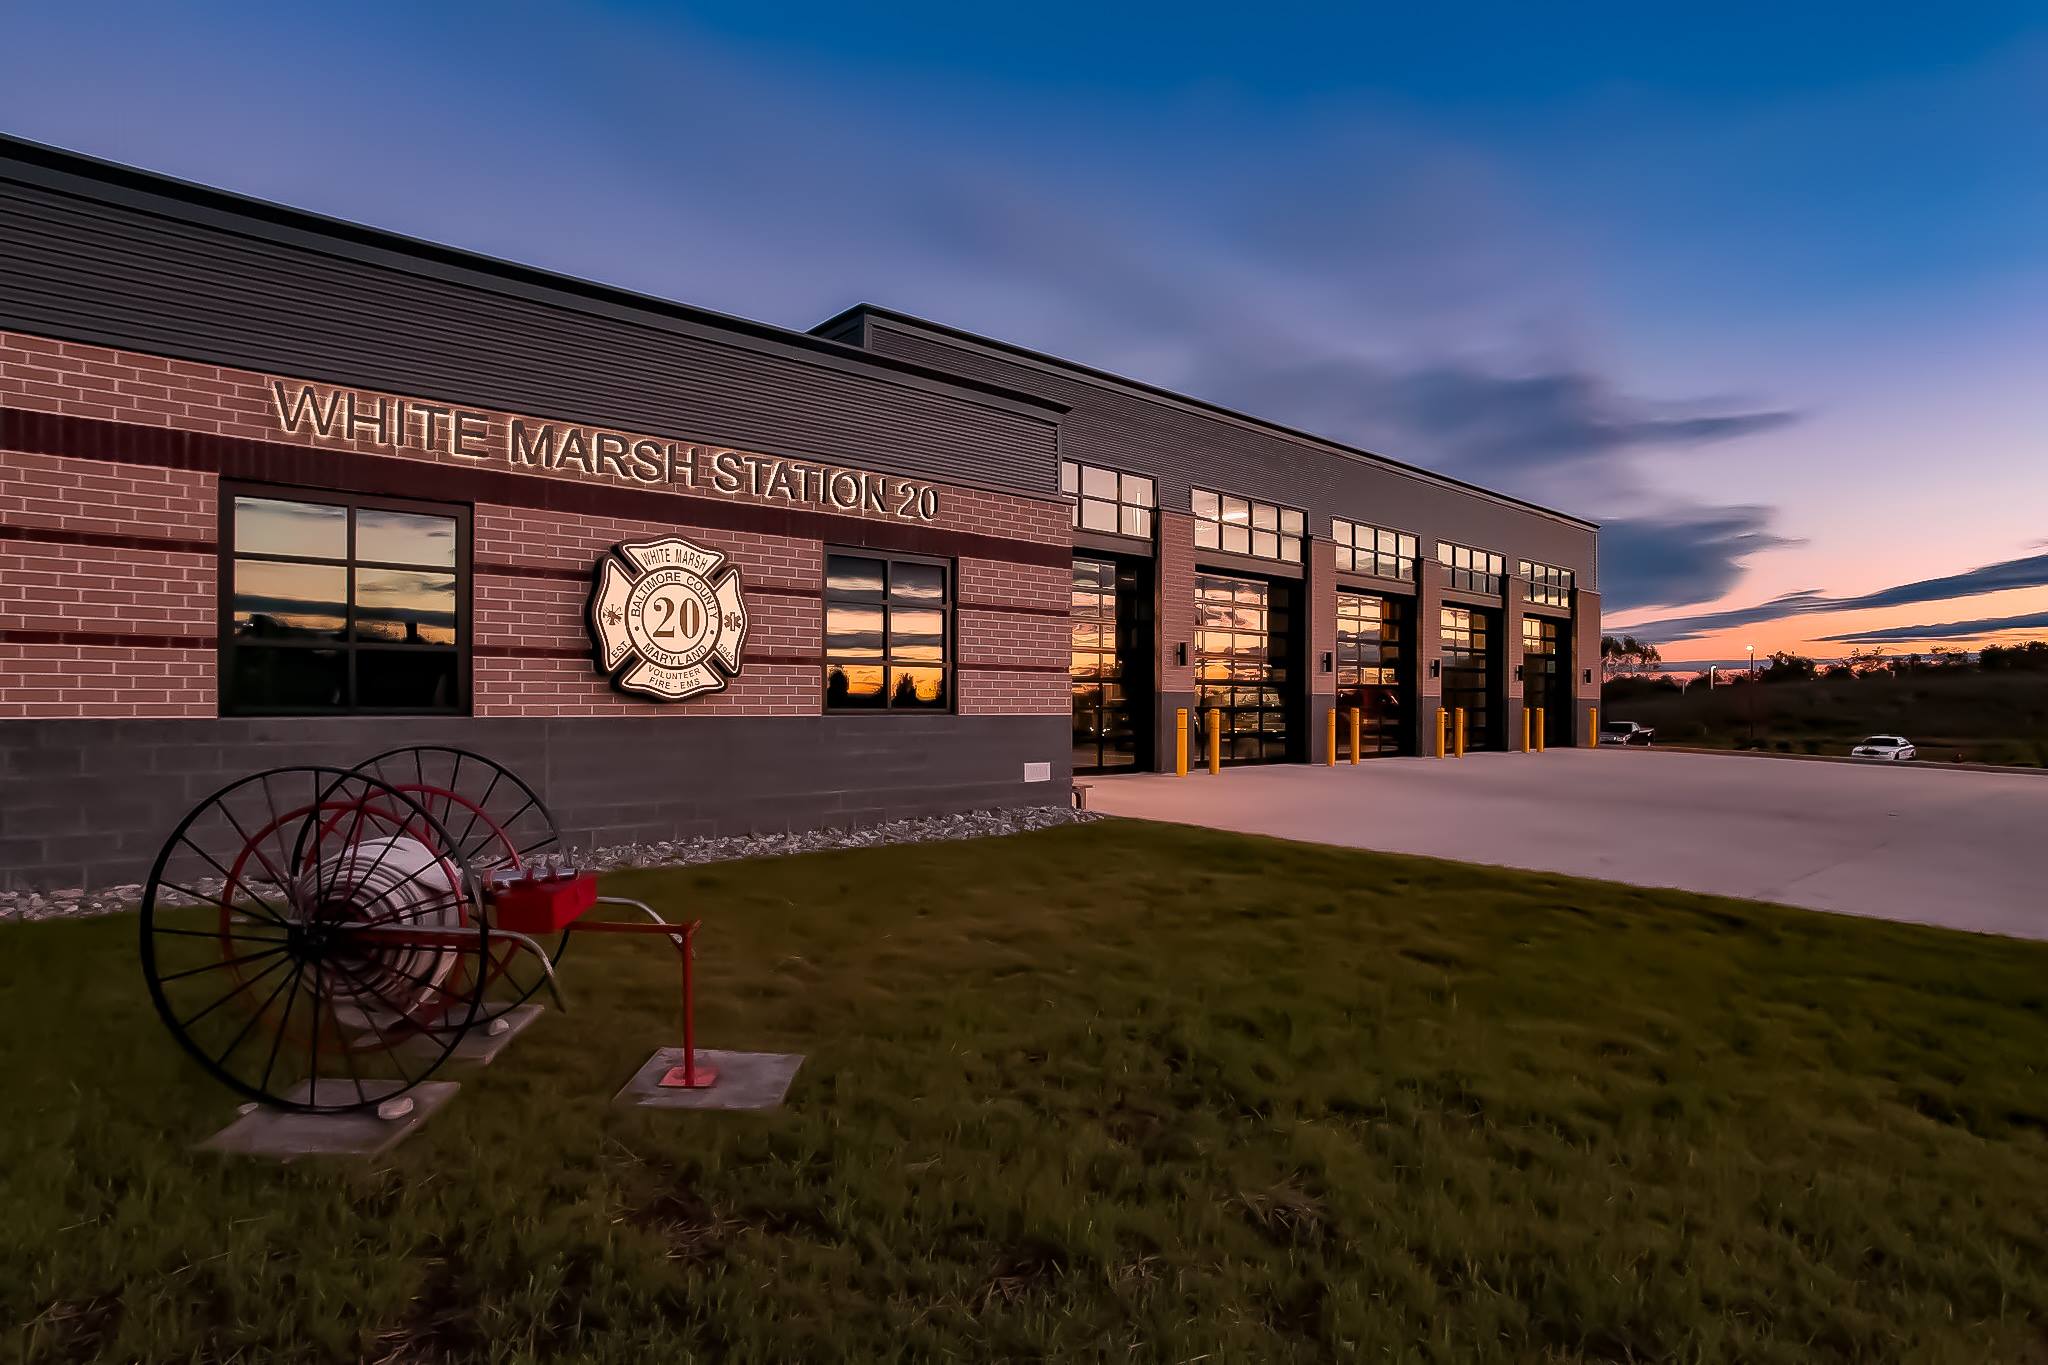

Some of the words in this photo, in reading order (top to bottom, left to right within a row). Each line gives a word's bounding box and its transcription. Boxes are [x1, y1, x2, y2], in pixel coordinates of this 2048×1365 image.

[272, 380, 490, 458] WHITE
[509, 418, 698, 487] MARSH
[714, 452, 888, 512] STATION
[899, 482, 939, 520] 20
[641, 548, 671, 567] WHITE
[675, 548, 709, 571] MARSH
[631, 572, 681, 617] BALTIMORE
[686, 576, 719, 619] COUNTY
[653, 597, 700, 639] 20
[611, 640, 630, 659] EST.
[643, 642, 707, 665] MARYLAND
[718, 643, 735, 662] 1945
[648, 664, 701, 680] VOLUNTEER
[649, 677, 670, 690] FIRE
[680, 678, 700, 690] EMS
